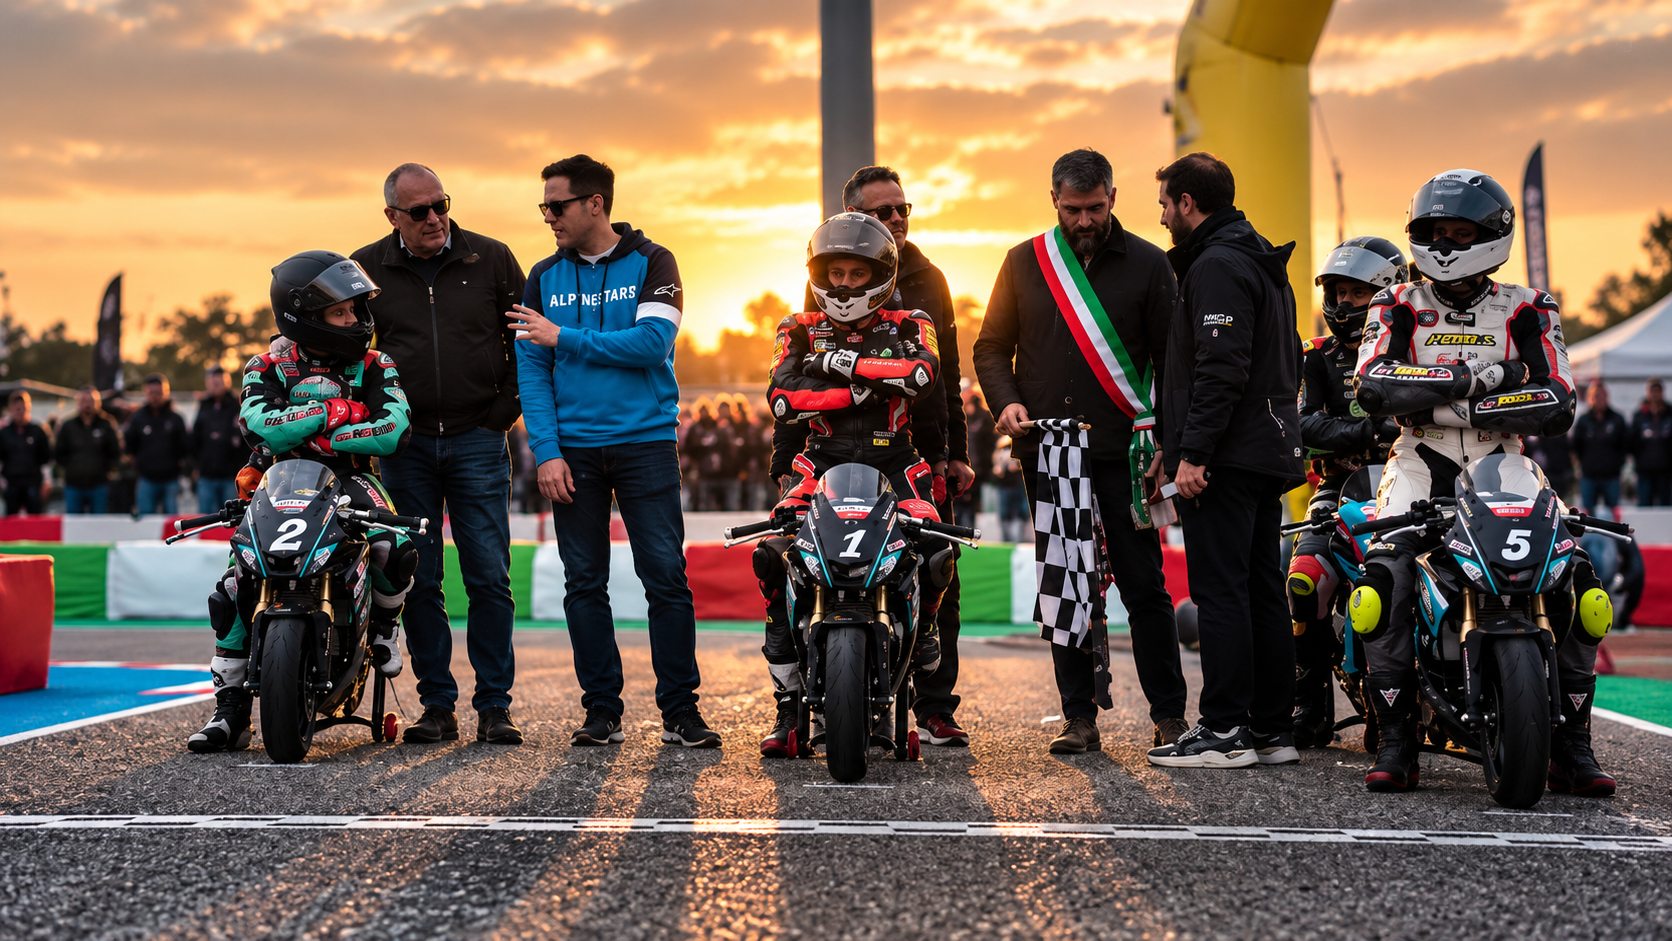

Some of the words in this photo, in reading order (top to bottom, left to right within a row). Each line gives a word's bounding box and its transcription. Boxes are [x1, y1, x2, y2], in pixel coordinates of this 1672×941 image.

[549, 285, 636, 308] ALPNESTARS
[269, 518, 308, 552] 2
[839, 529, 867, 558] 1
[1501, 529, 1532, 561] 5
